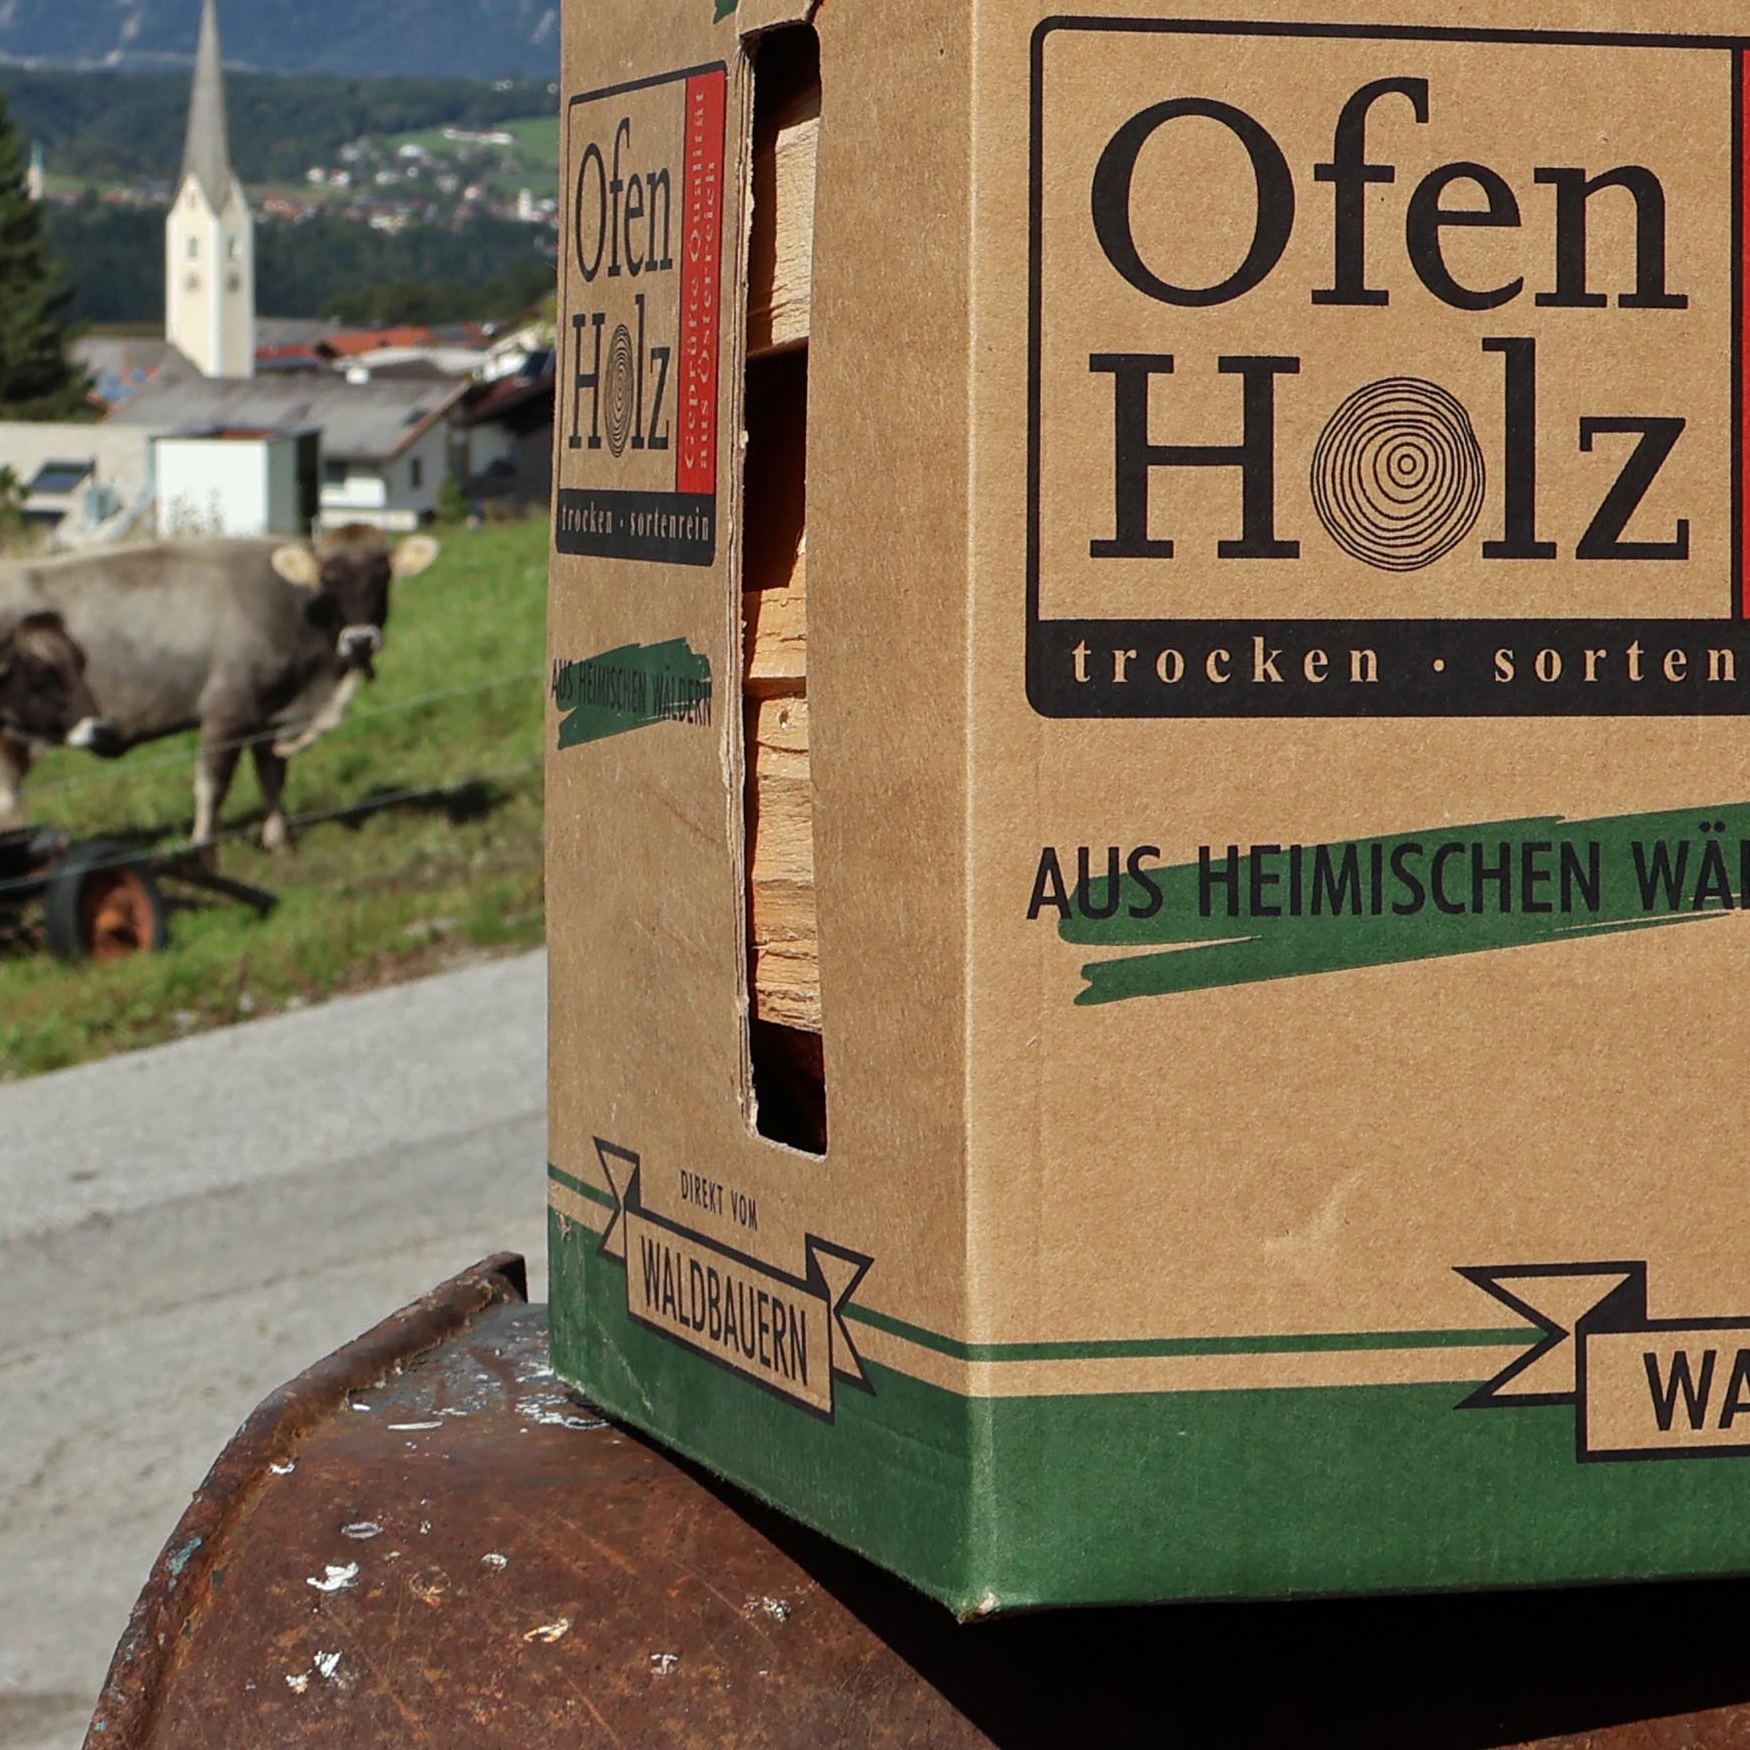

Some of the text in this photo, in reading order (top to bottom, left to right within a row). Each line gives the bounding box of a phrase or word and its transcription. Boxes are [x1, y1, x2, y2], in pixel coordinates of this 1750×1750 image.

[574, 116, 673, 284] Ofen
[1090, 76, 1689, 311] Ofen
[567, 293, 671, 458] Holz
[561, 501, 710, 541] trocken sortenrein
[1088, 337, 1690, 573] Holz
[1071, 636, 1382, 684] trocken
[1027, 845, 1164, 921] AUS
[1197, 840, 1601, 918] HEIMISCHEN
[680, 1168, 758, 1232] DIREKT VOM
[641, 1235, 809, 1387] WALDBAUERN
